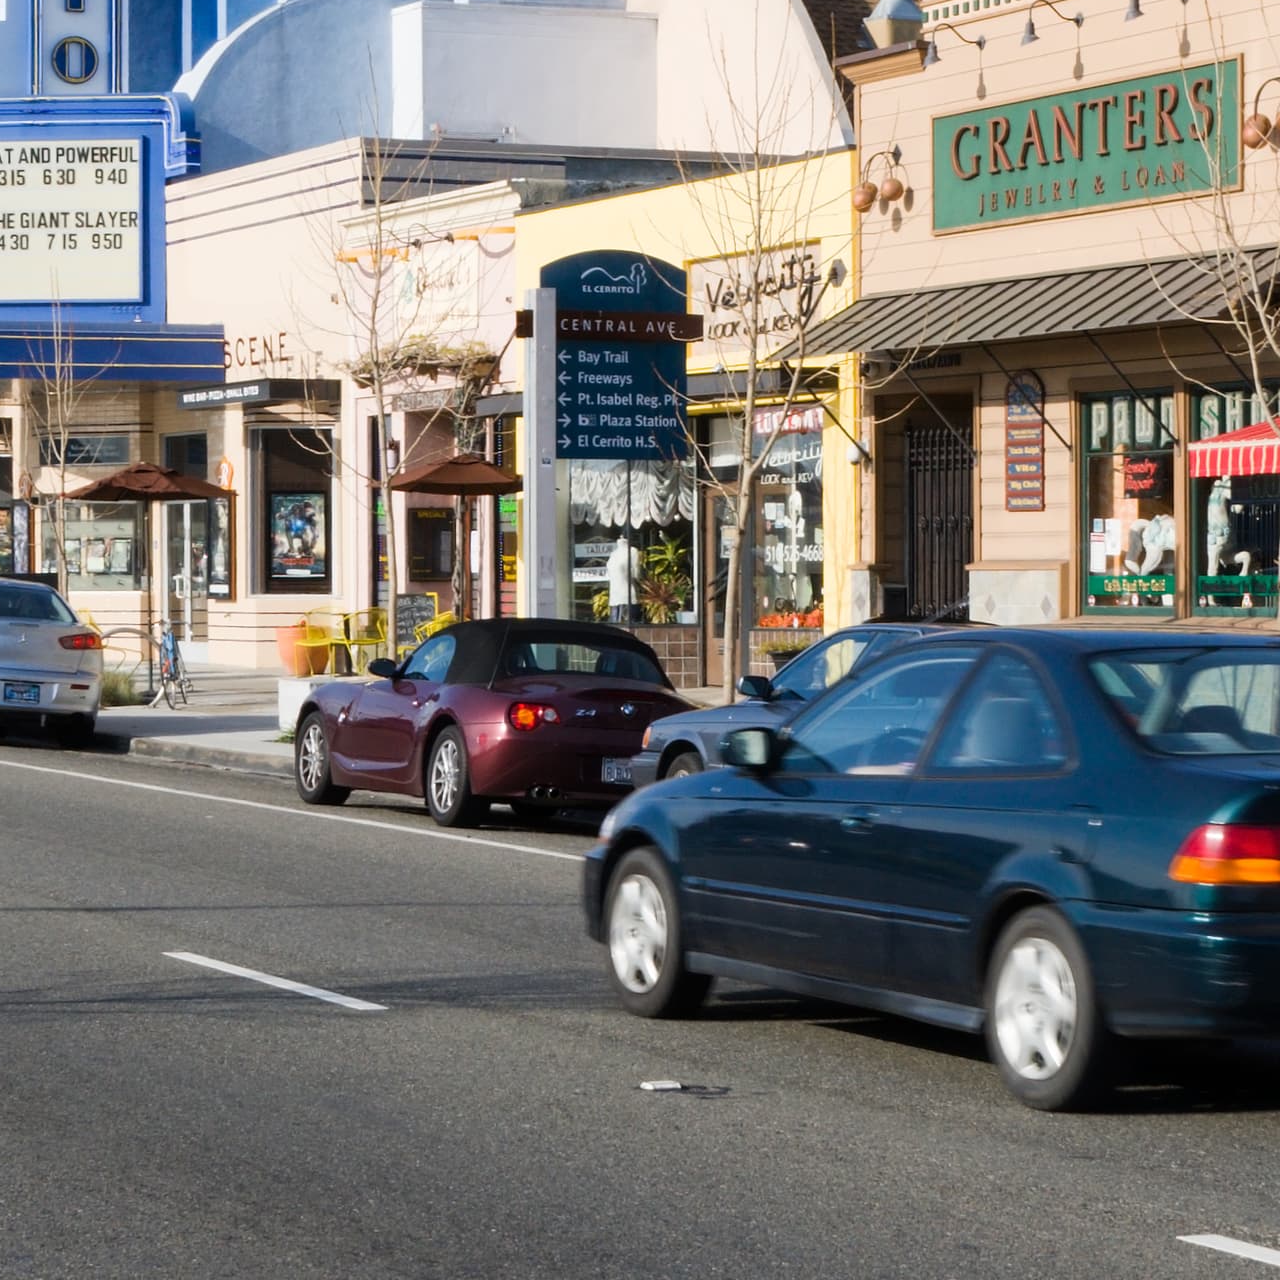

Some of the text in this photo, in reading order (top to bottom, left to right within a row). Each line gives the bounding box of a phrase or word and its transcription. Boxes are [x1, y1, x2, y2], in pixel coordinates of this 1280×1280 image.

[950, 78, 1214, 180] GRANTERS
[18, 147, 51, 164] AND
[56, 146, 138, 164] POWERFUL
[978, 160, 1186, 216] JEWELRY & LOAN
[20, 212, 70, 229] GIANT
[75, 211, 138, 228] SLAYER
[582, 285, 634, 294] EL CERRITO
[560, 319, 636, 333] CENTRAL
[578, 350, 629, 365] Bay Trail
[578, 372, 633, 387] Freeways
[578, 393, 594, 405] Pt.
[596, 393, 633, 406] Isabel
[636, 394, 662, 409] Reg.
[599, 414, 631, 427] Plaza
[635, 414, 677, 428] Station
[578, 435, 659, 448] El Cerrito H.S.
[761, 474, 781, 485] LOCK
[798, 473, 814, 485] KEY
